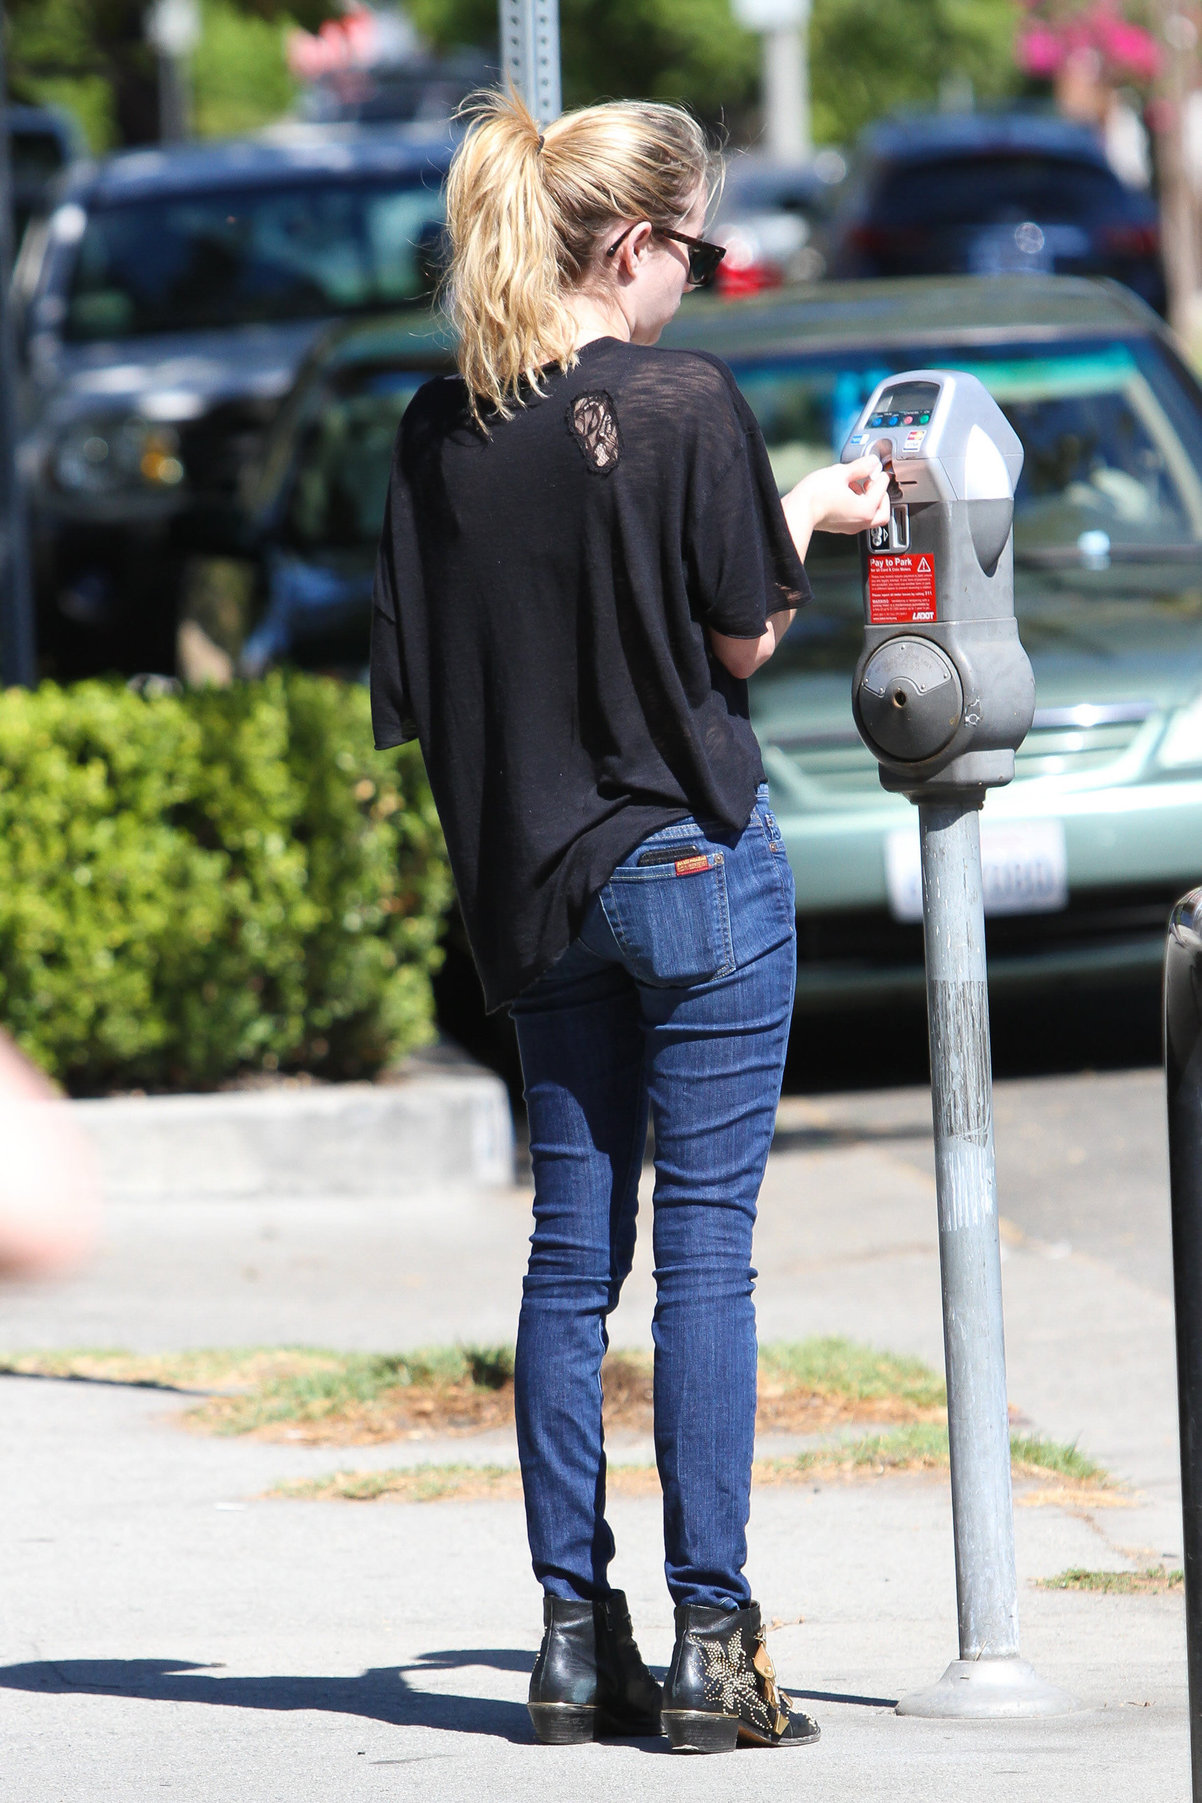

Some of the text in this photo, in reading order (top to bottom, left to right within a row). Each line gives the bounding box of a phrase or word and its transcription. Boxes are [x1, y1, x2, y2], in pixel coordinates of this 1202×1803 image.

[870, 557, 912, 568] Pay to Park
